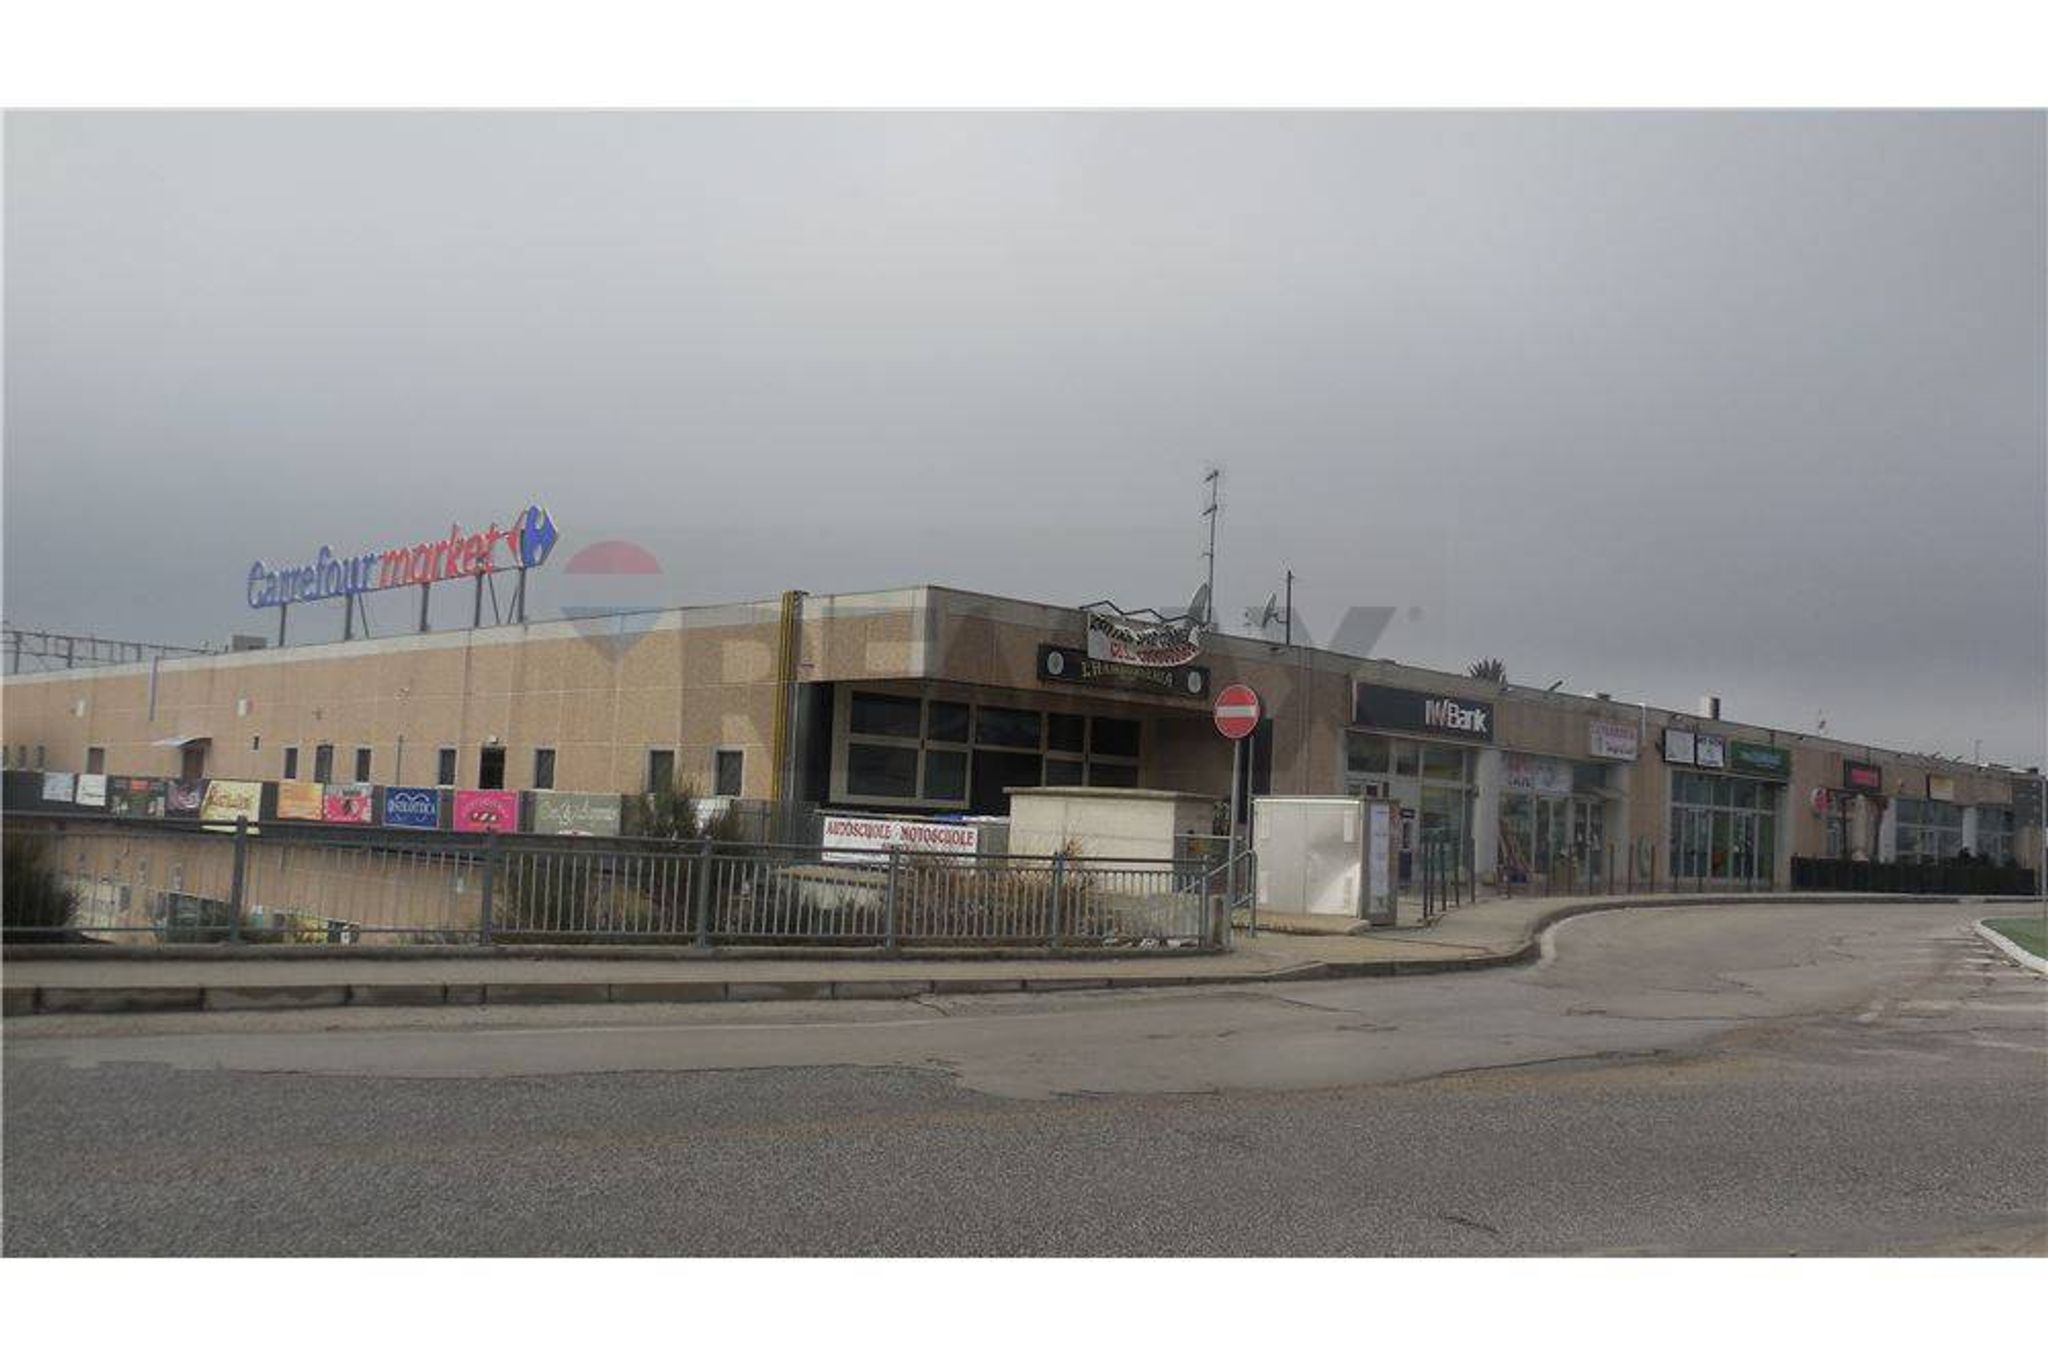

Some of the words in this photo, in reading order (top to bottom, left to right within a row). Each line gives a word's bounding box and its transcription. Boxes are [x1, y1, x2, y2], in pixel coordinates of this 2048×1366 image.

[248, 546, 376, 609] Carrefour
[378, 522, 498, 589] market
[825, 820, 891, 839] AUTOSCUOLE
[900, 826, 975, 847] MOTOSCUOLE
